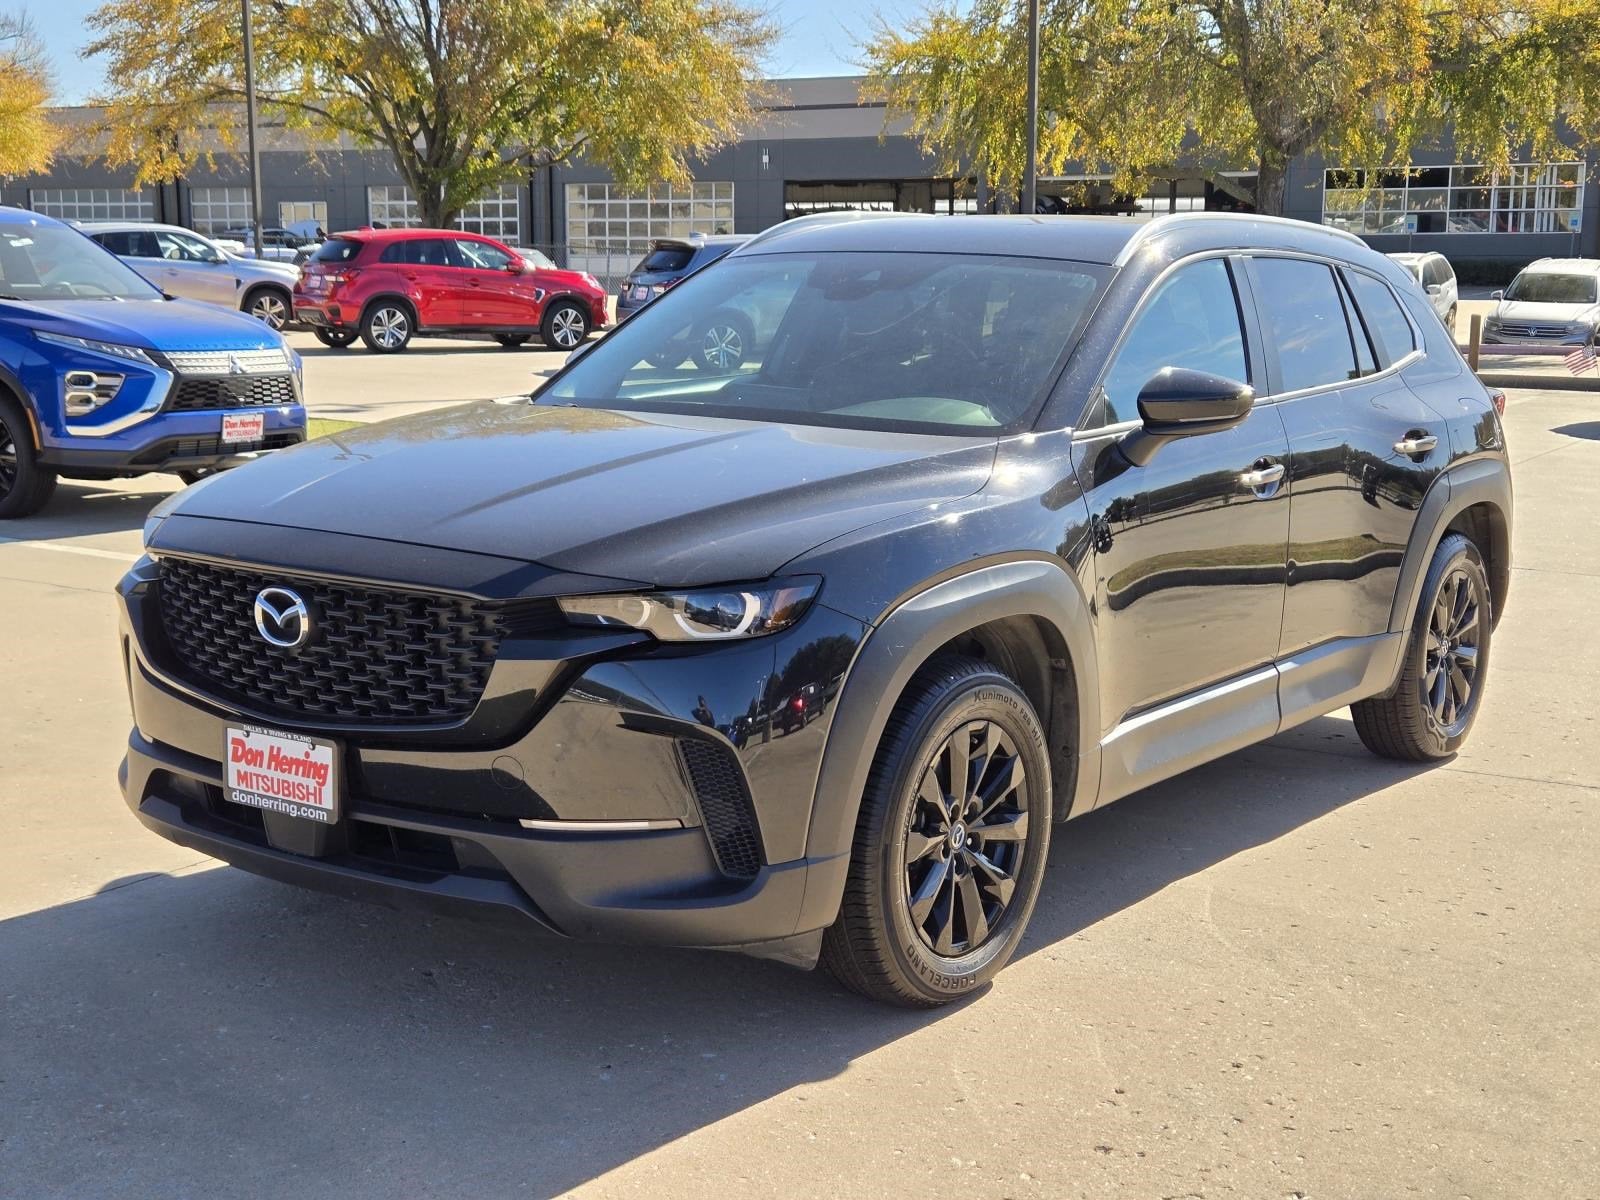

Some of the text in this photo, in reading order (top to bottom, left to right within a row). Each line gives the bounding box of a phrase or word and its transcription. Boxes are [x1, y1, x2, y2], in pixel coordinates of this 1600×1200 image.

[974, 689, 1018, 709] Kunimoto
[293, 734, 312, 743] PLANO
[231, 736, 329, 787] Don Herring
[236, 769, 323, 806] MITSUBISHI
[231, 789, 328, 821] donherring.com
[906, 944, 977, 989] FORCELAND
